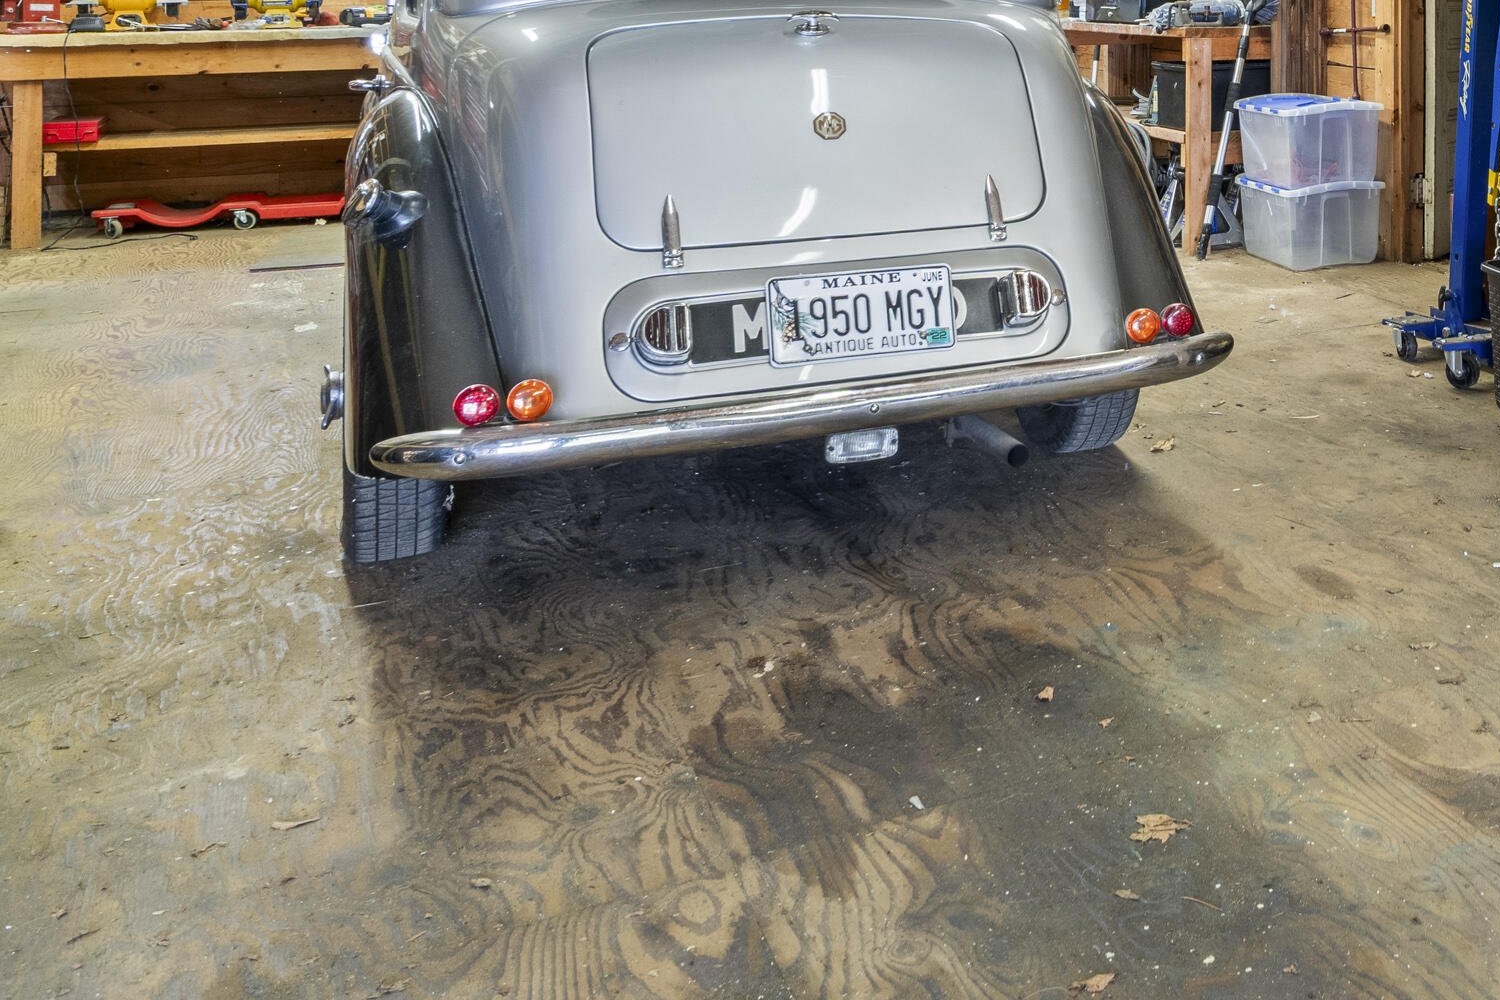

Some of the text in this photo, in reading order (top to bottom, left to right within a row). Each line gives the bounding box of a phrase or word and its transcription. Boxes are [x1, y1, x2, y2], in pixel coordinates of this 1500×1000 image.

[822, 271, 944, 290] MAINE JUNE
[792, 293, 872, 342] 1950
[885, 286, 944, 333] MGY
[816, 334, 916, 355] ANTIQUE AUTO
